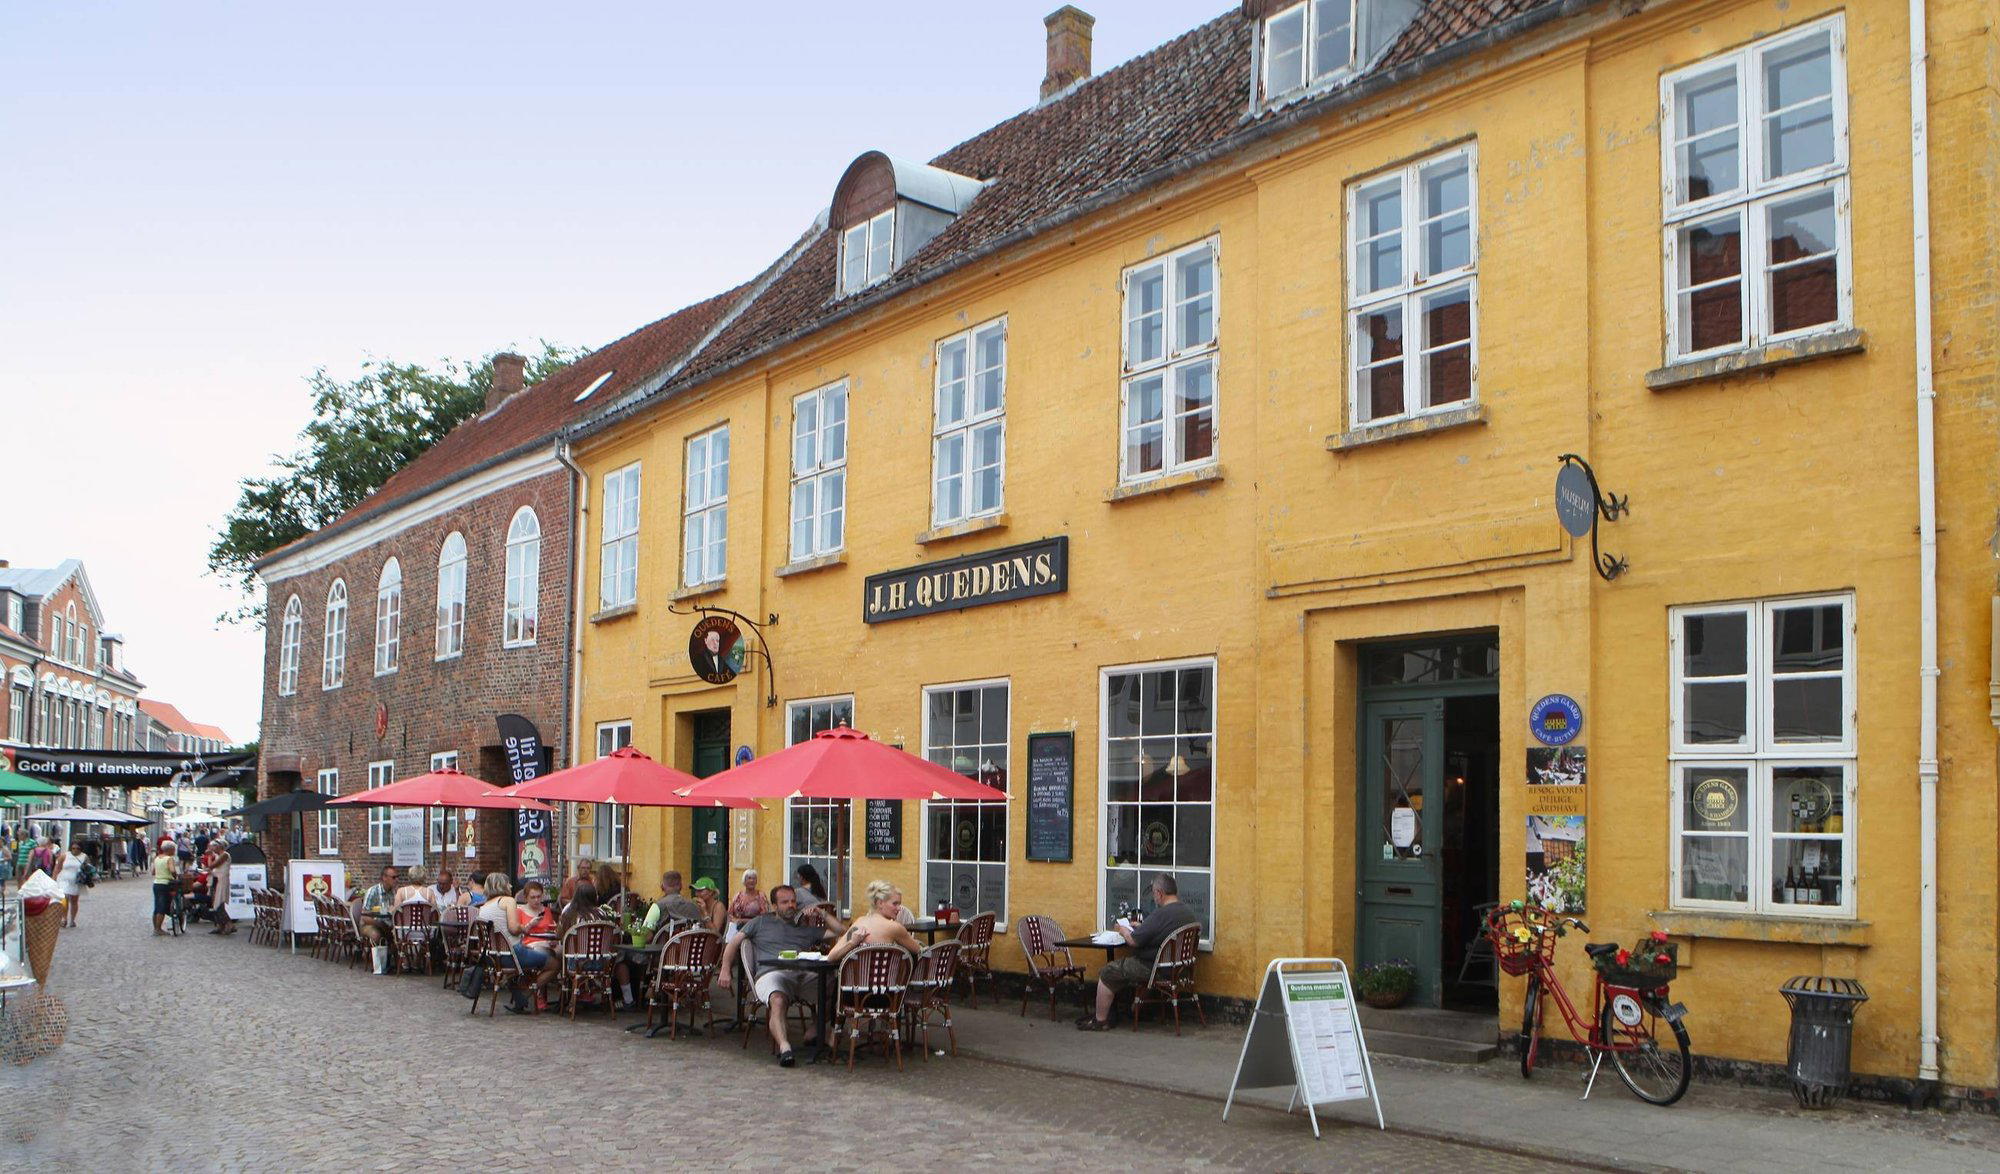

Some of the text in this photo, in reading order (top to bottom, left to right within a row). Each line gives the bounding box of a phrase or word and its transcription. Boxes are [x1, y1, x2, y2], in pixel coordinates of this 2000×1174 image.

[916, 553, 1057, 608] QUEDENS.
[18, 760, 172, 776] Godt øl til danskerne
